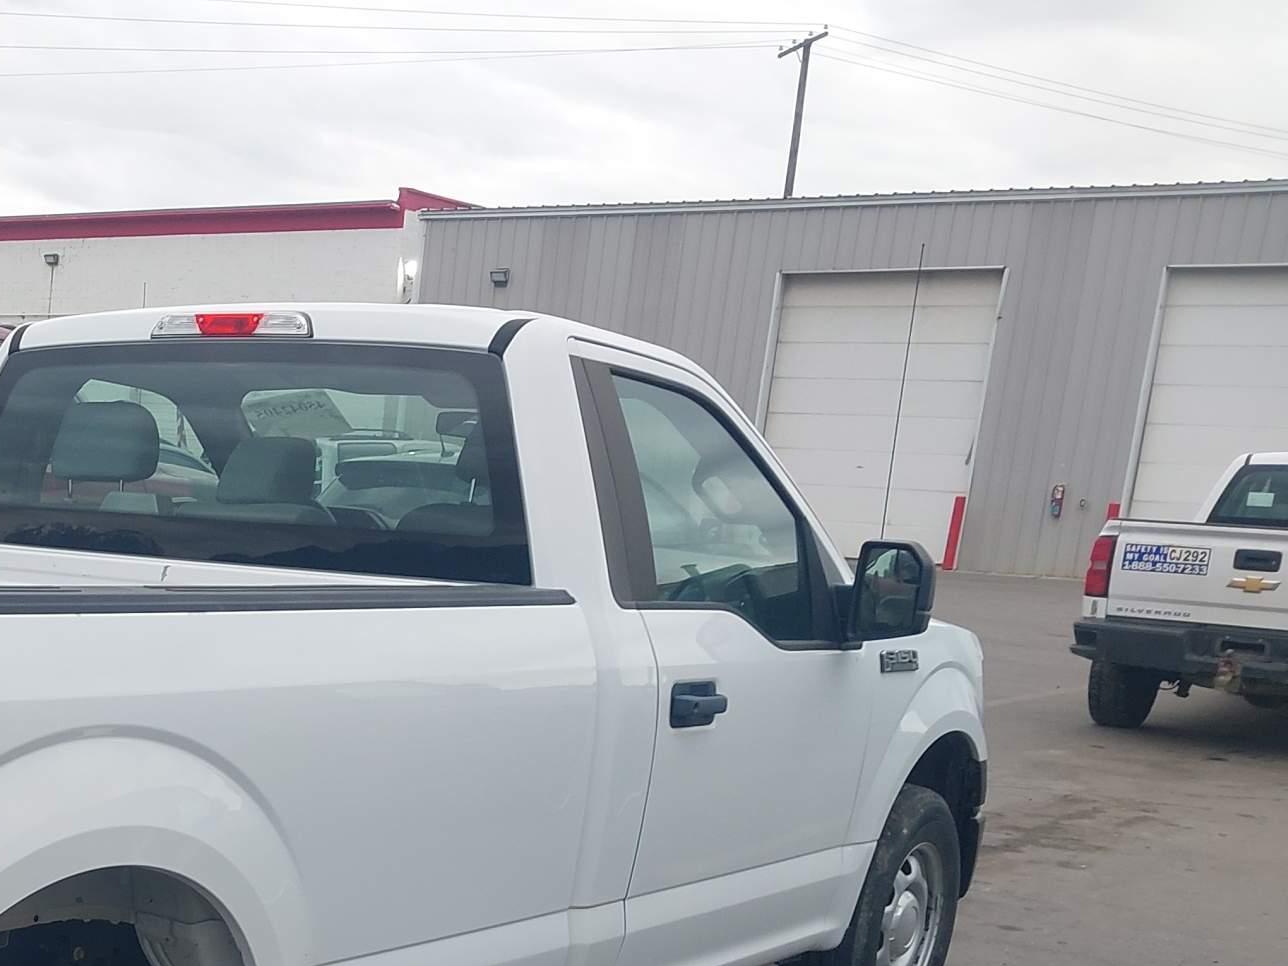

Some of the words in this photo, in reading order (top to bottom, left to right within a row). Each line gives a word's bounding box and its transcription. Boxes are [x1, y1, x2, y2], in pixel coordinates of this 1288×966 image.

[1125, 544, 1157, 553] SAFETY
[1124, 553, 1140, 561] MY
[1142, 554, 1166, 562] GOAL
[1169, 549, 1208, 563] CJ292
